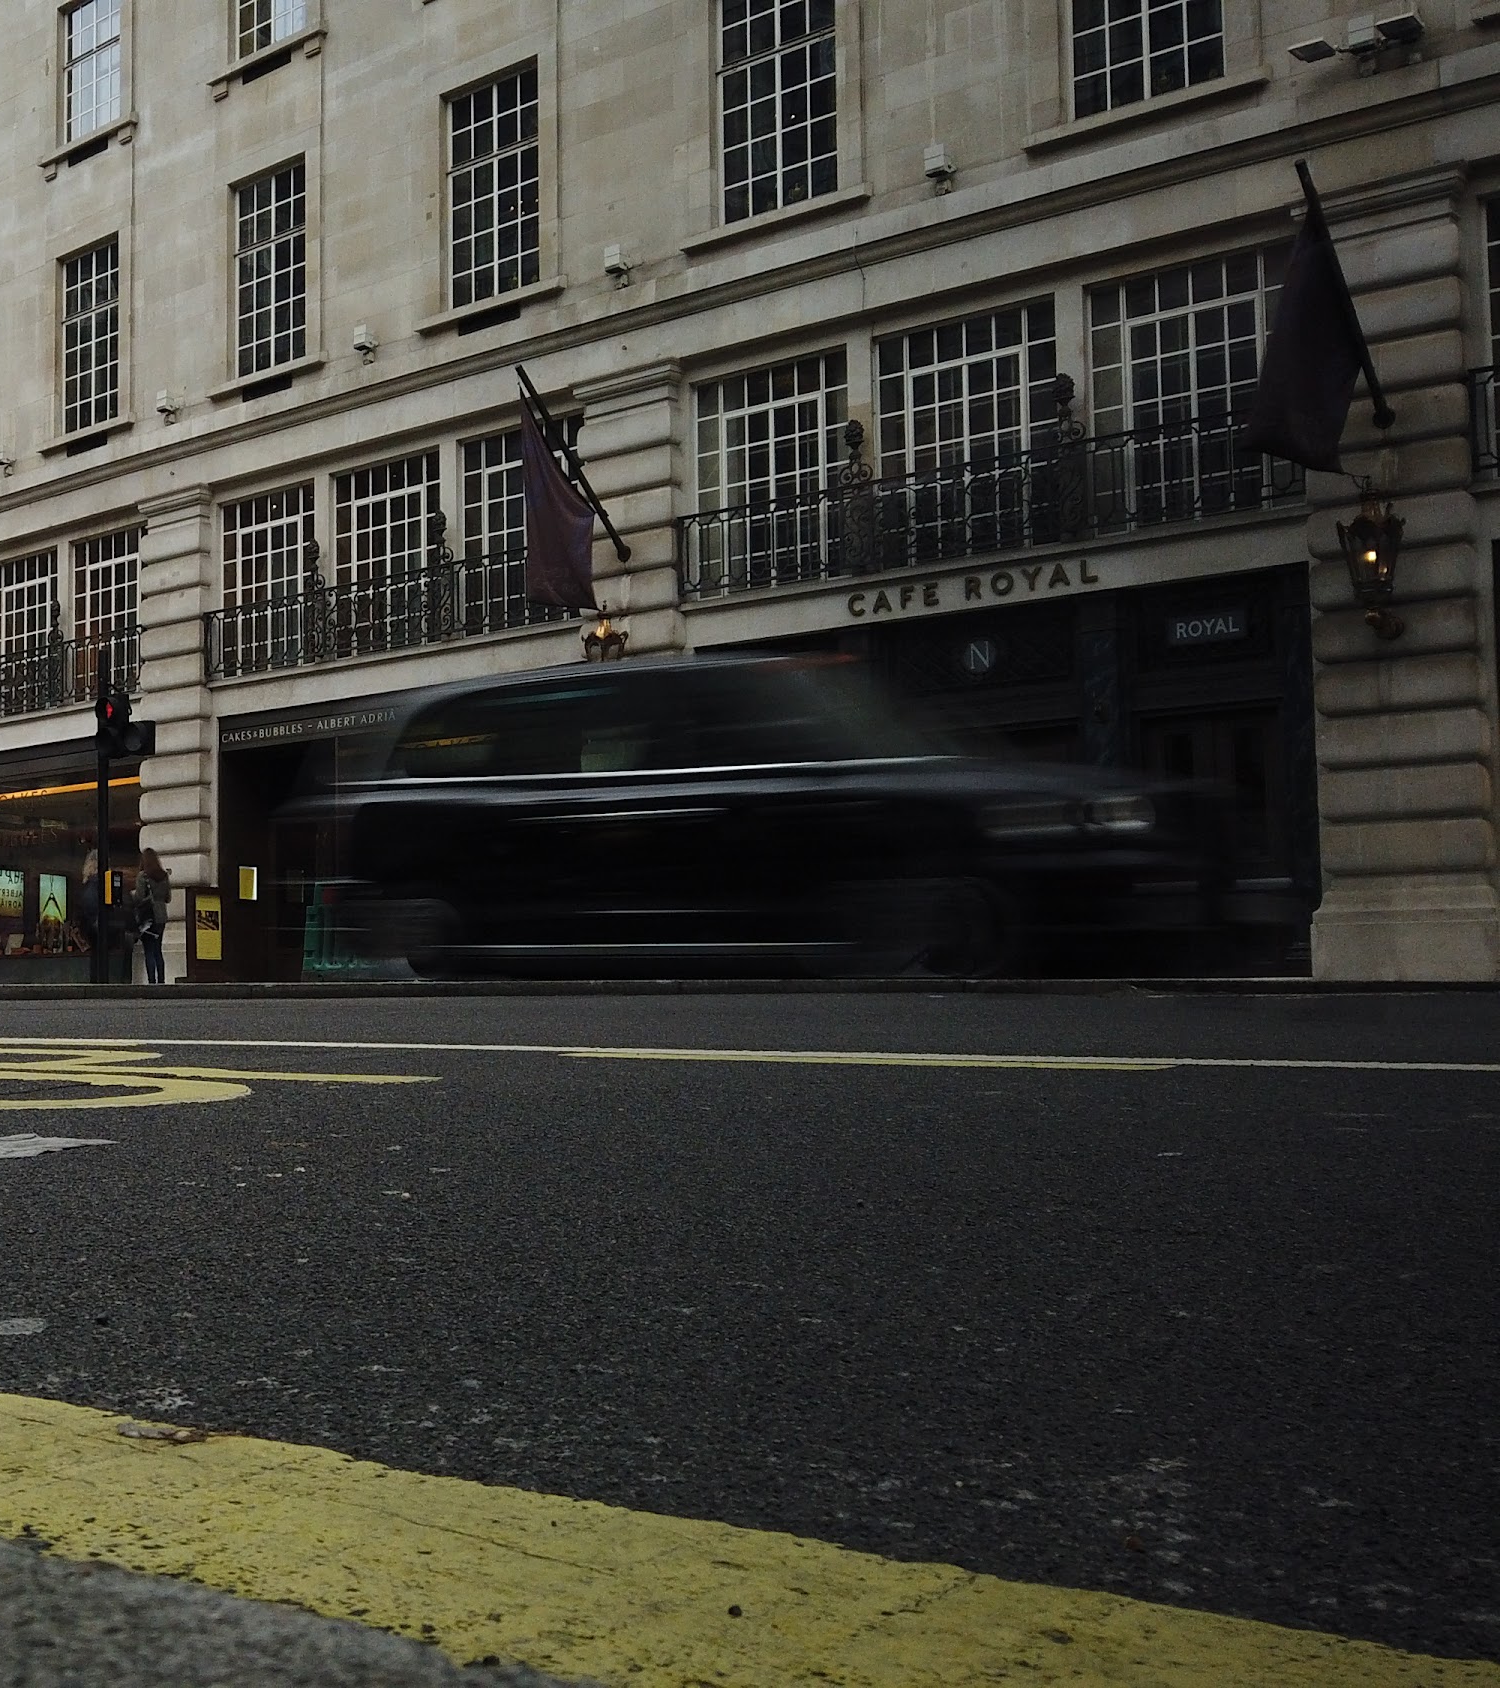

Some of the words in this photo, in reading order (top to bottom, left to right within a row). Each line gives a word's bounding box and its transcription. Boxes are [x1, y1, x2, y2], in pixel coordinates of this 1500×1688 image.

[847, 581, 941, 618] CAFE
[963, 559, 1100, 602] ROYAL
[1176, 615, 1241, 640] ROYAL
[970, 640, 990, 670] N
[316, 716, 357, 730] ALBERT
